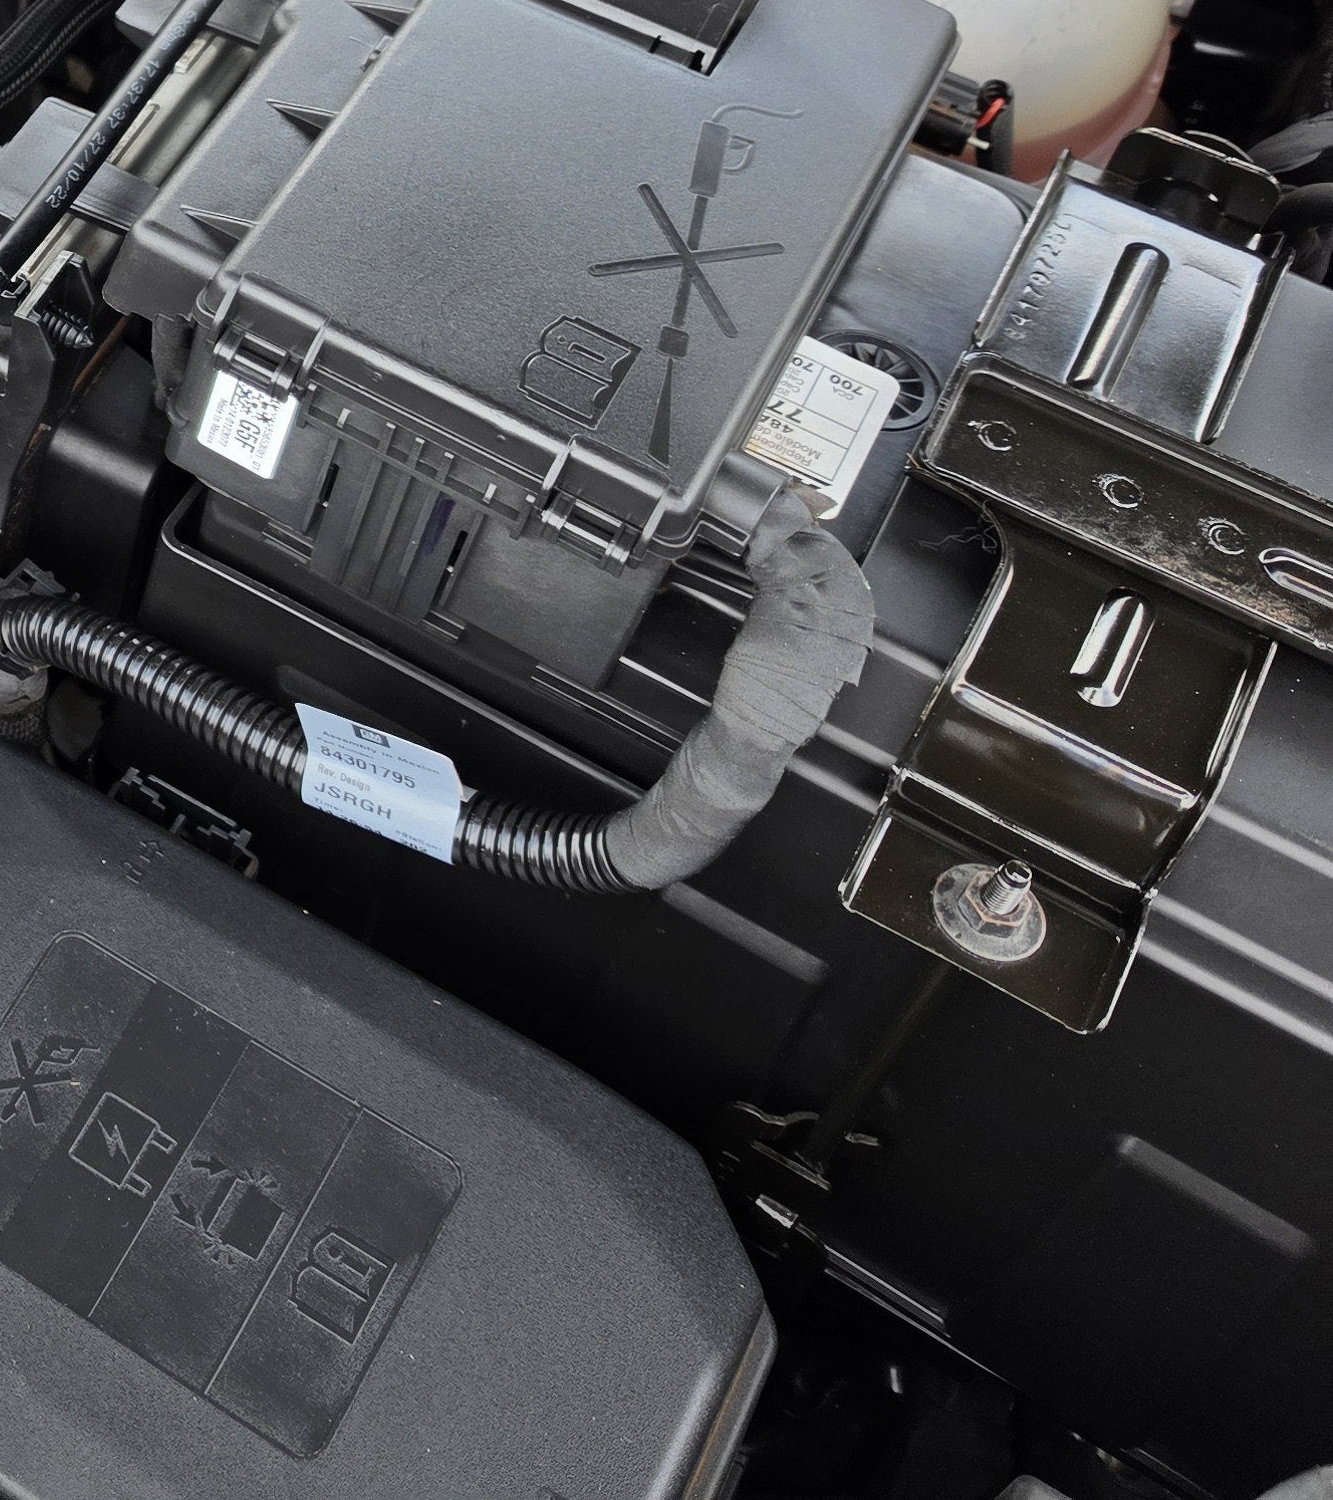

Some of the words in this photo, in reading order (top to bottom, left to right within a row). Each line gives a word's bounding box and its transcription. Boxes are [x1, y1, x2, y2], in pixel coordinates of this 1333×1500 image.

[104, 57, 161, 130] 17:37:37
[44, 131, 107, 209] 27/10/22
[830, 374, 864, 396] 700
[767, 400, 804, 424] 77
[235, 420, 260, 453] G5F
[318, 763, 336, 779] Rev.
[340, 772, 370, 792] Design
[321, 745, 415, 788] 84301795
[314, 782, 391, 819] JSRGH
